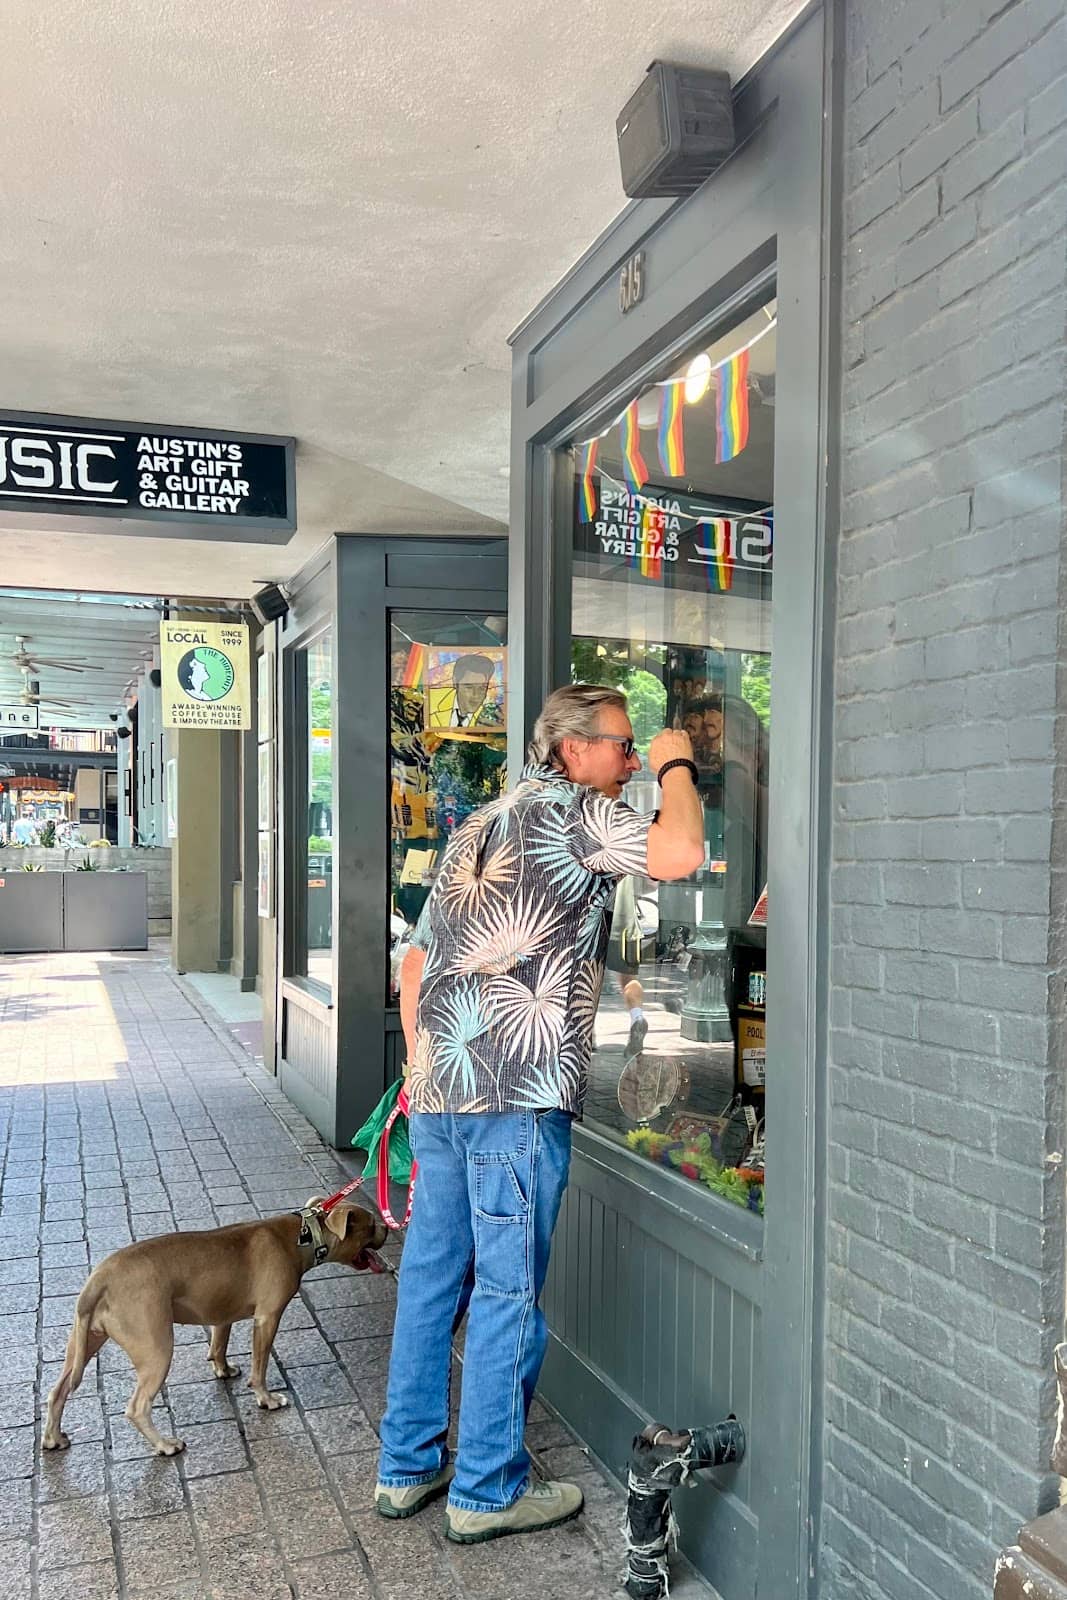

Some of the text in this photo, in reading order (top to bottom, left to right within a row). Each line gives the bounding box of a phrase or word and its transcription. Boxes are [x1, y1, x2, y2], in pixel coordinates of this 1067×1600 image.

[136, 436, 243, 461] AUSTIN'S
[0, 436, 119, 493] SIC
[137, 454, 243, 478] ART GIFT
[139, 473, 250, 497] & GUITAR
[139, 491, 242, 514] GALLERY
[167, 632, 208, 644] LOCAL
[221, 630, 243, 638] SINCE
[222, 638, 242, 646] 1999
[172, 703, 242, 712] AWARD-WINNING
[172, 710, 242, 719] COFFEE HOUSE
[210, 718, 242, 726] THEATRE
